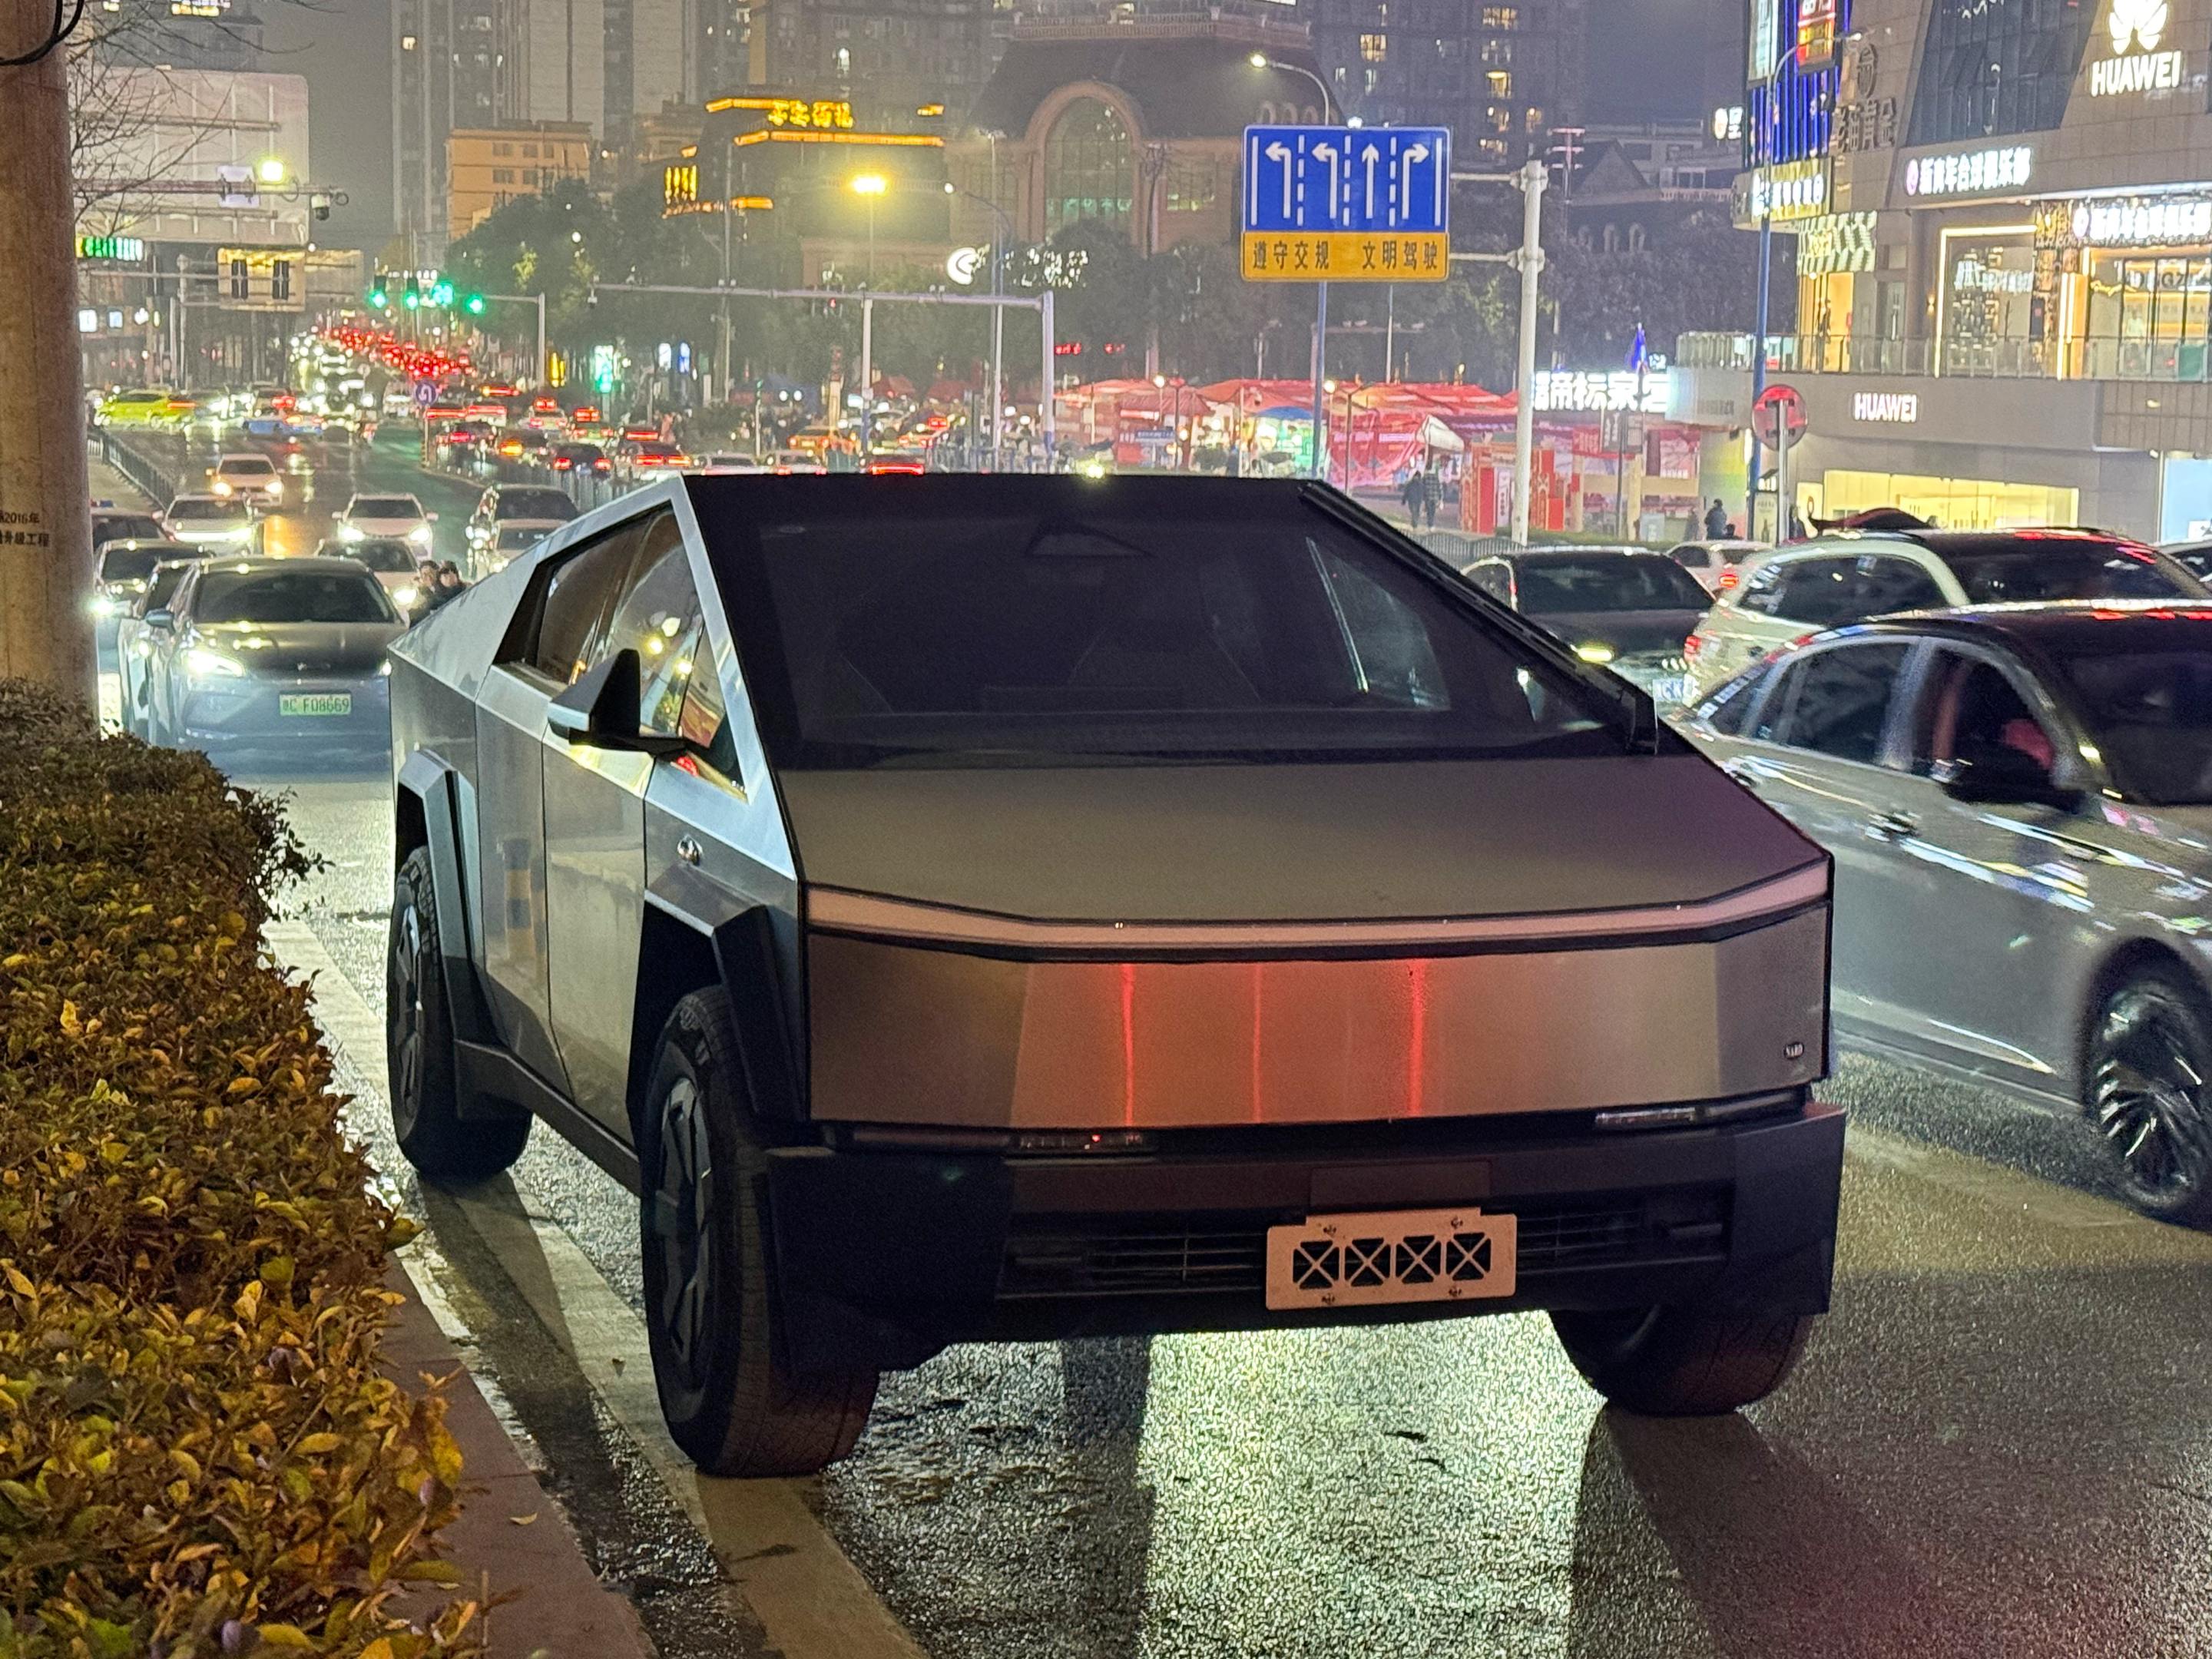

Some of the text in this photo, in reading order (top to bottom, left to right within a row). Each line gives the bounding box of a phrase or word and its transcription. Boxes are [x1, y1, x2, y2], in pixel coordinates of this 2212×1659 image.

[2091, 50, 2181, 98] HUAWEI
[1253, 240, 1438, 270] 遵守交规 文明驾驶
[1853, 392, 1917, 423] HUAWEI
[0, 512, 40, 524] 2016年
[0, 530, 49, 547] 升级工程
